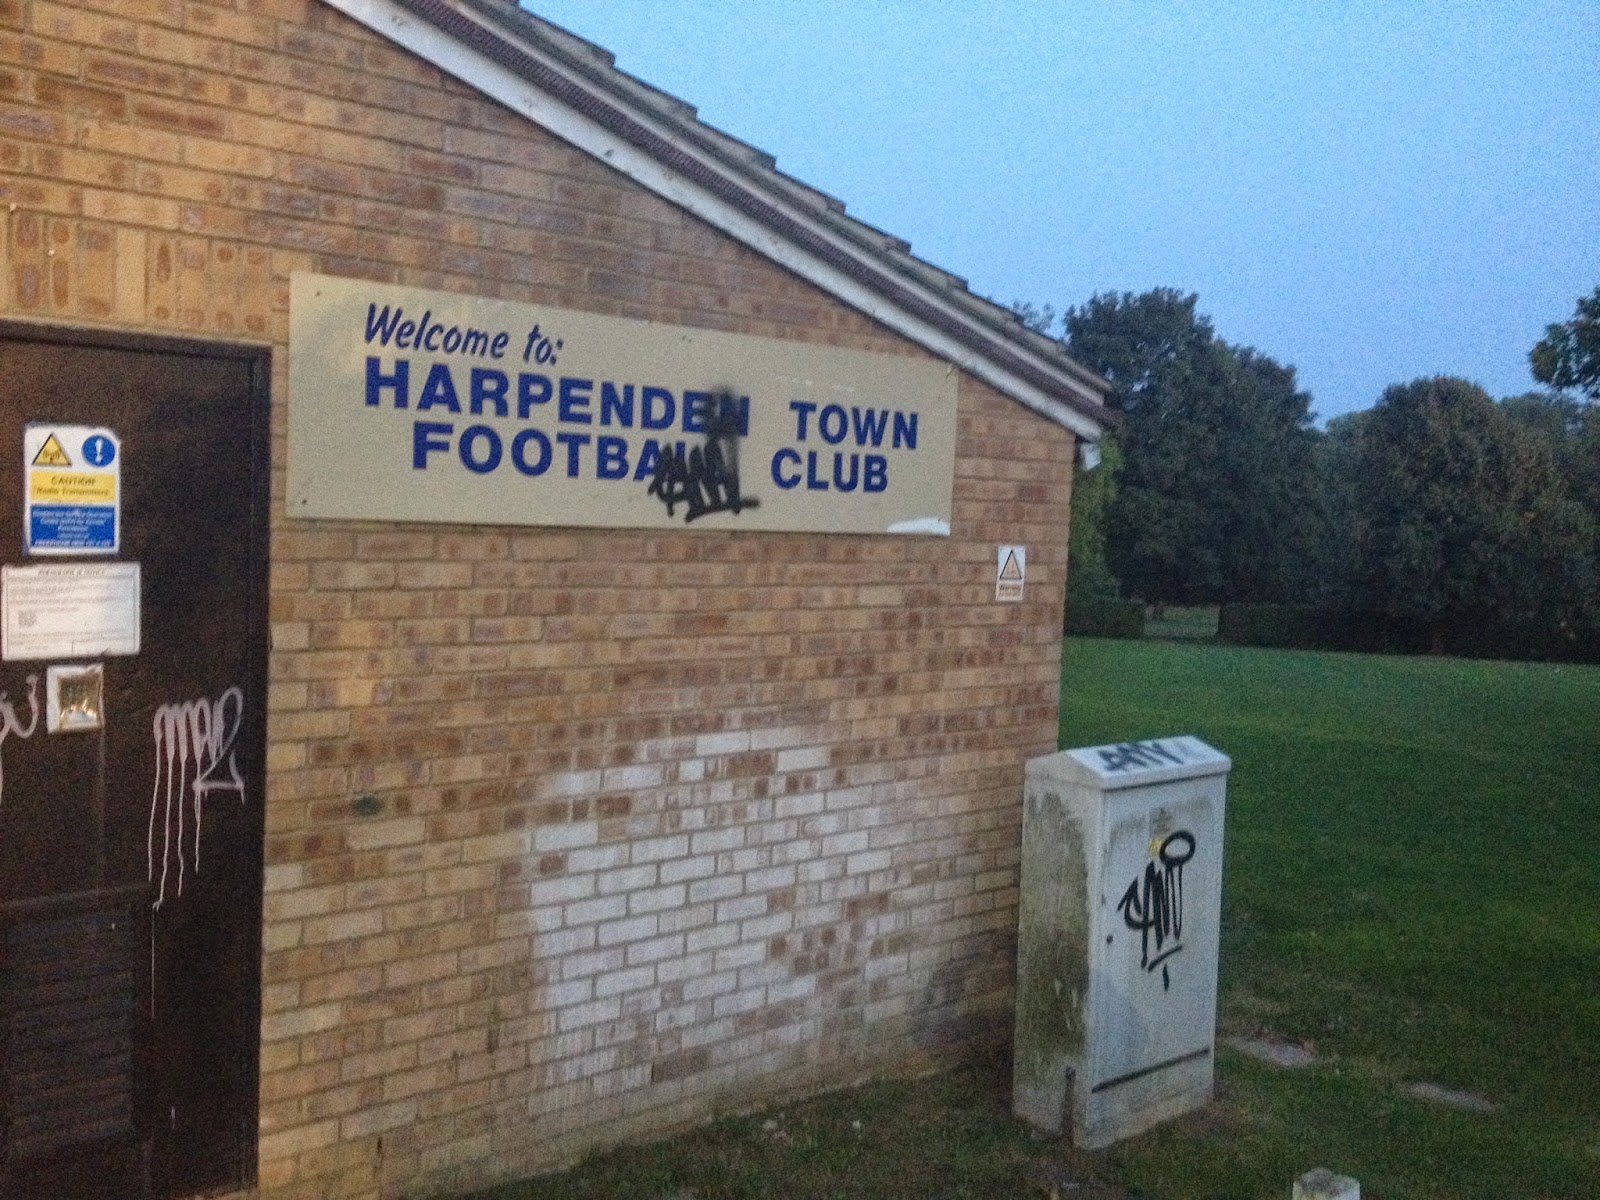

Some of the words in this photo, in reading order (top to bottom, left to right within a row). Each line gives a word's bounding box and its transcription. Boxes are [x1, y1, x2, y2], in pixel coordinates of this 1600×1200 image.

[364, 302, 510, 359] Welcome
[522, 324, 565, 366] to:
[364, 355, 750, 438] HARPENDEN
[789, 401, 919, 450] TOWN
[50, 475, 96, 487] CAUTION
[412, 420, 738, 489] FOOTBA
[770, 447, 890, 494] CLUB
